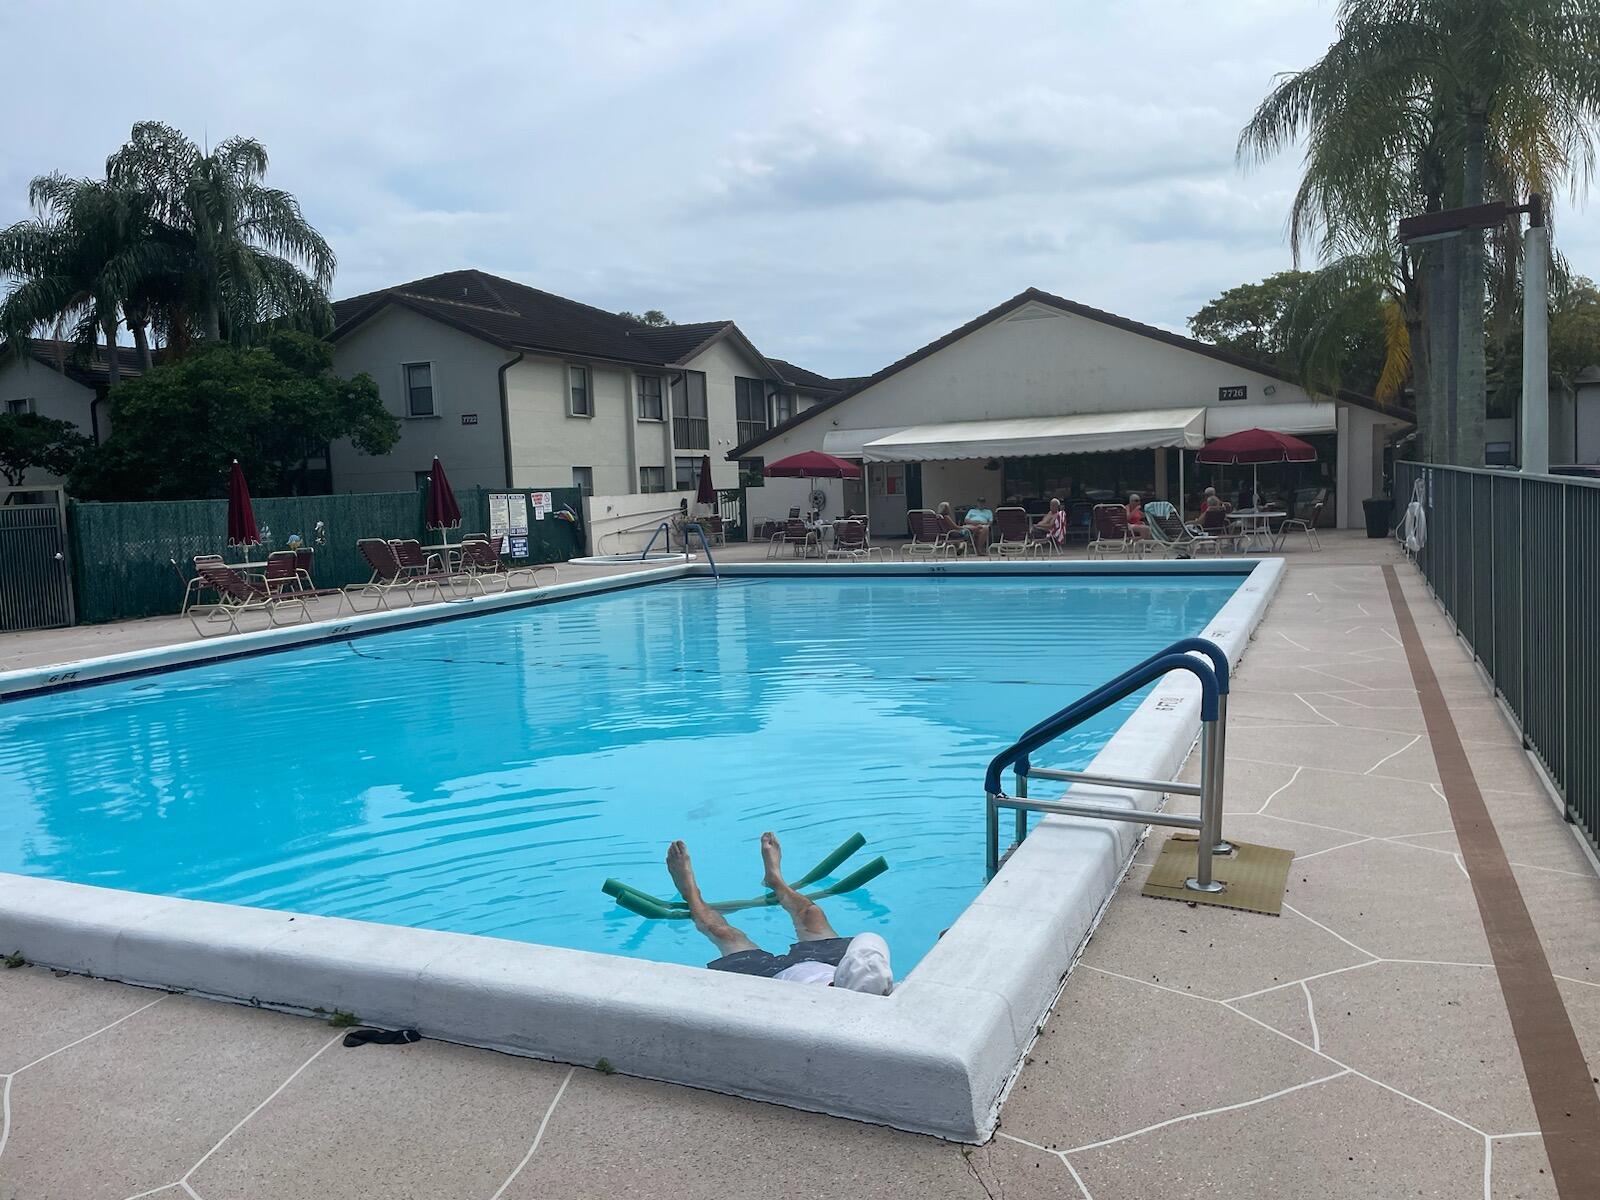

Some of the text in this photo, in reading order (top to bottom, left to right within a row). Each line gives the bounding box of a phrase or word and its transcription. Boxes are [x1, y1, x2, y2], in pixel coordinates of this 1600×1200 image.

[1222, 388, 1244, 398] 7726
[49, 671, 81, 682] 6 FT
